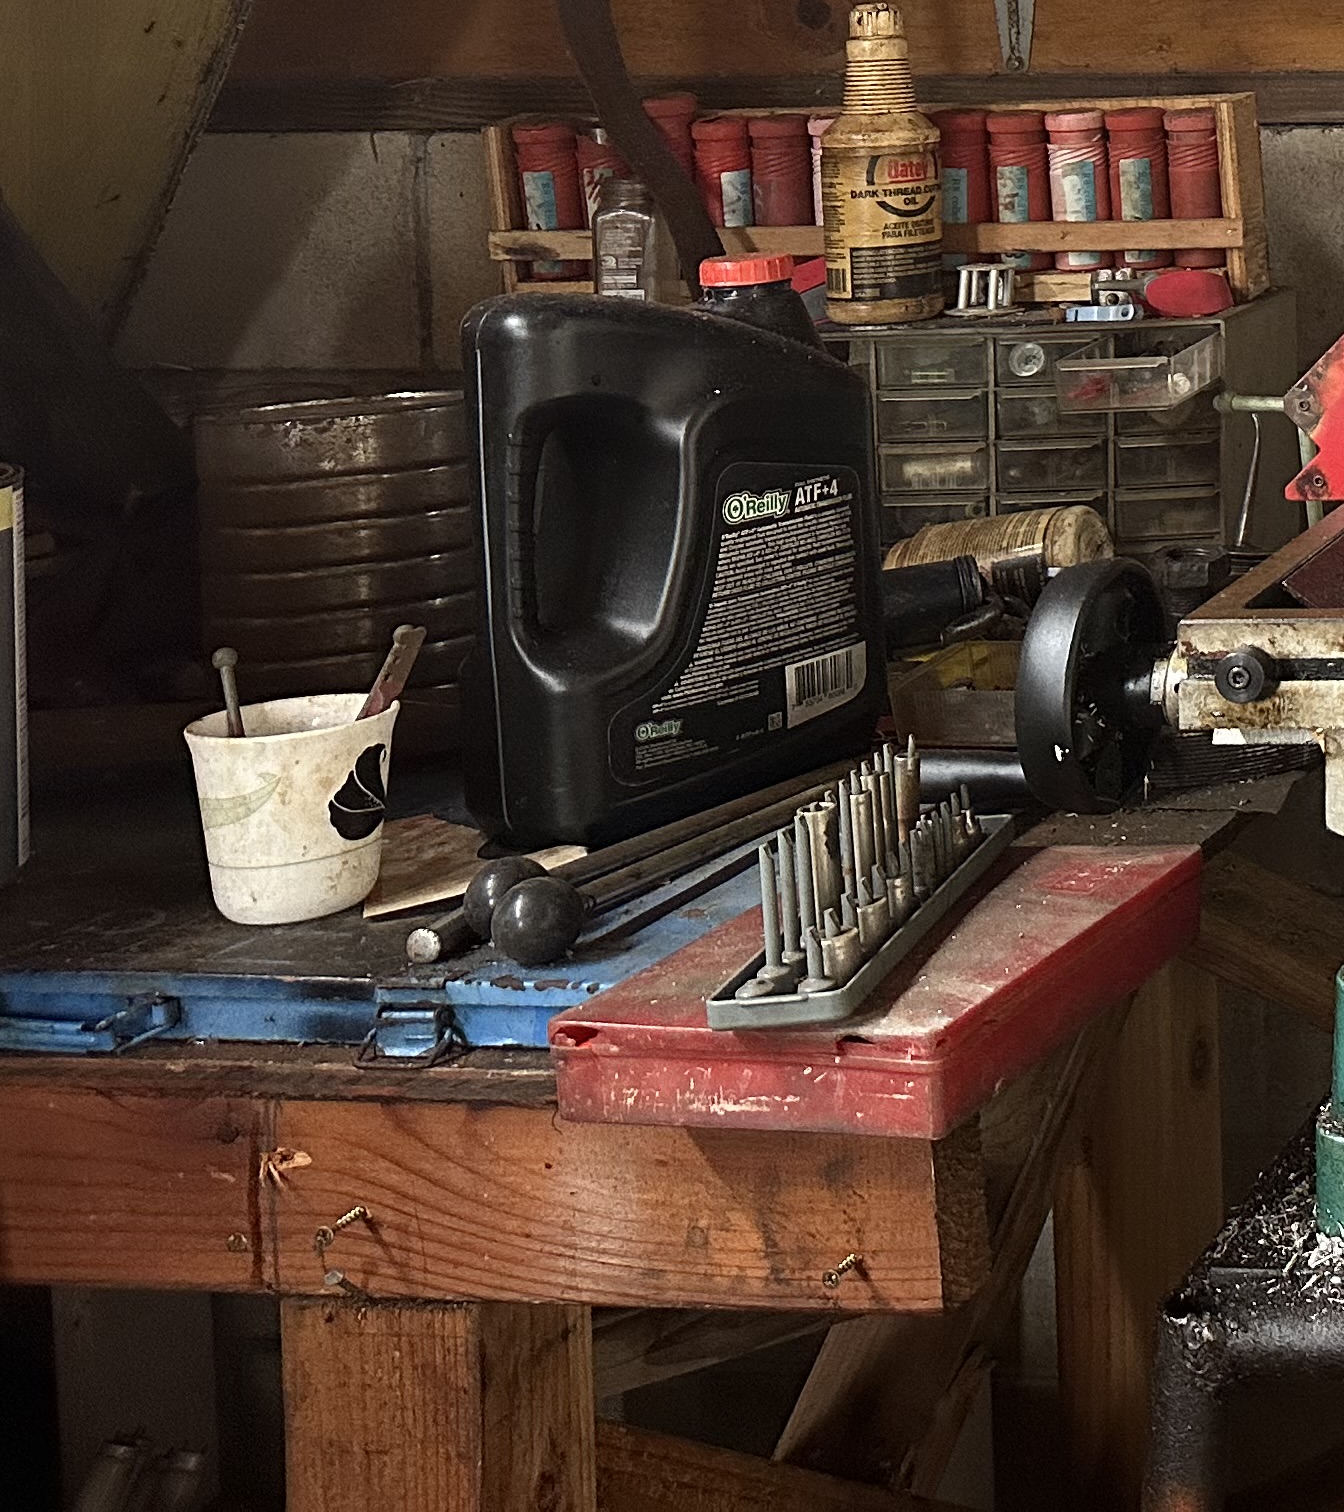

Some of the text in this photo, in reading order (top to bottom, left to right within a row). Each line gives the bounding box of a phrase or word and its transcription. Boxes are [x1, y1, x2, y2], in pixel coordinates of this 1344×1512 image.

[850, 189, 878, 199] DARK
[882, 186, 921, 197] THREAD
[903, 197, 919, 206] OIL
[726, 478, 839, 523] O'Reilly ATF+4
